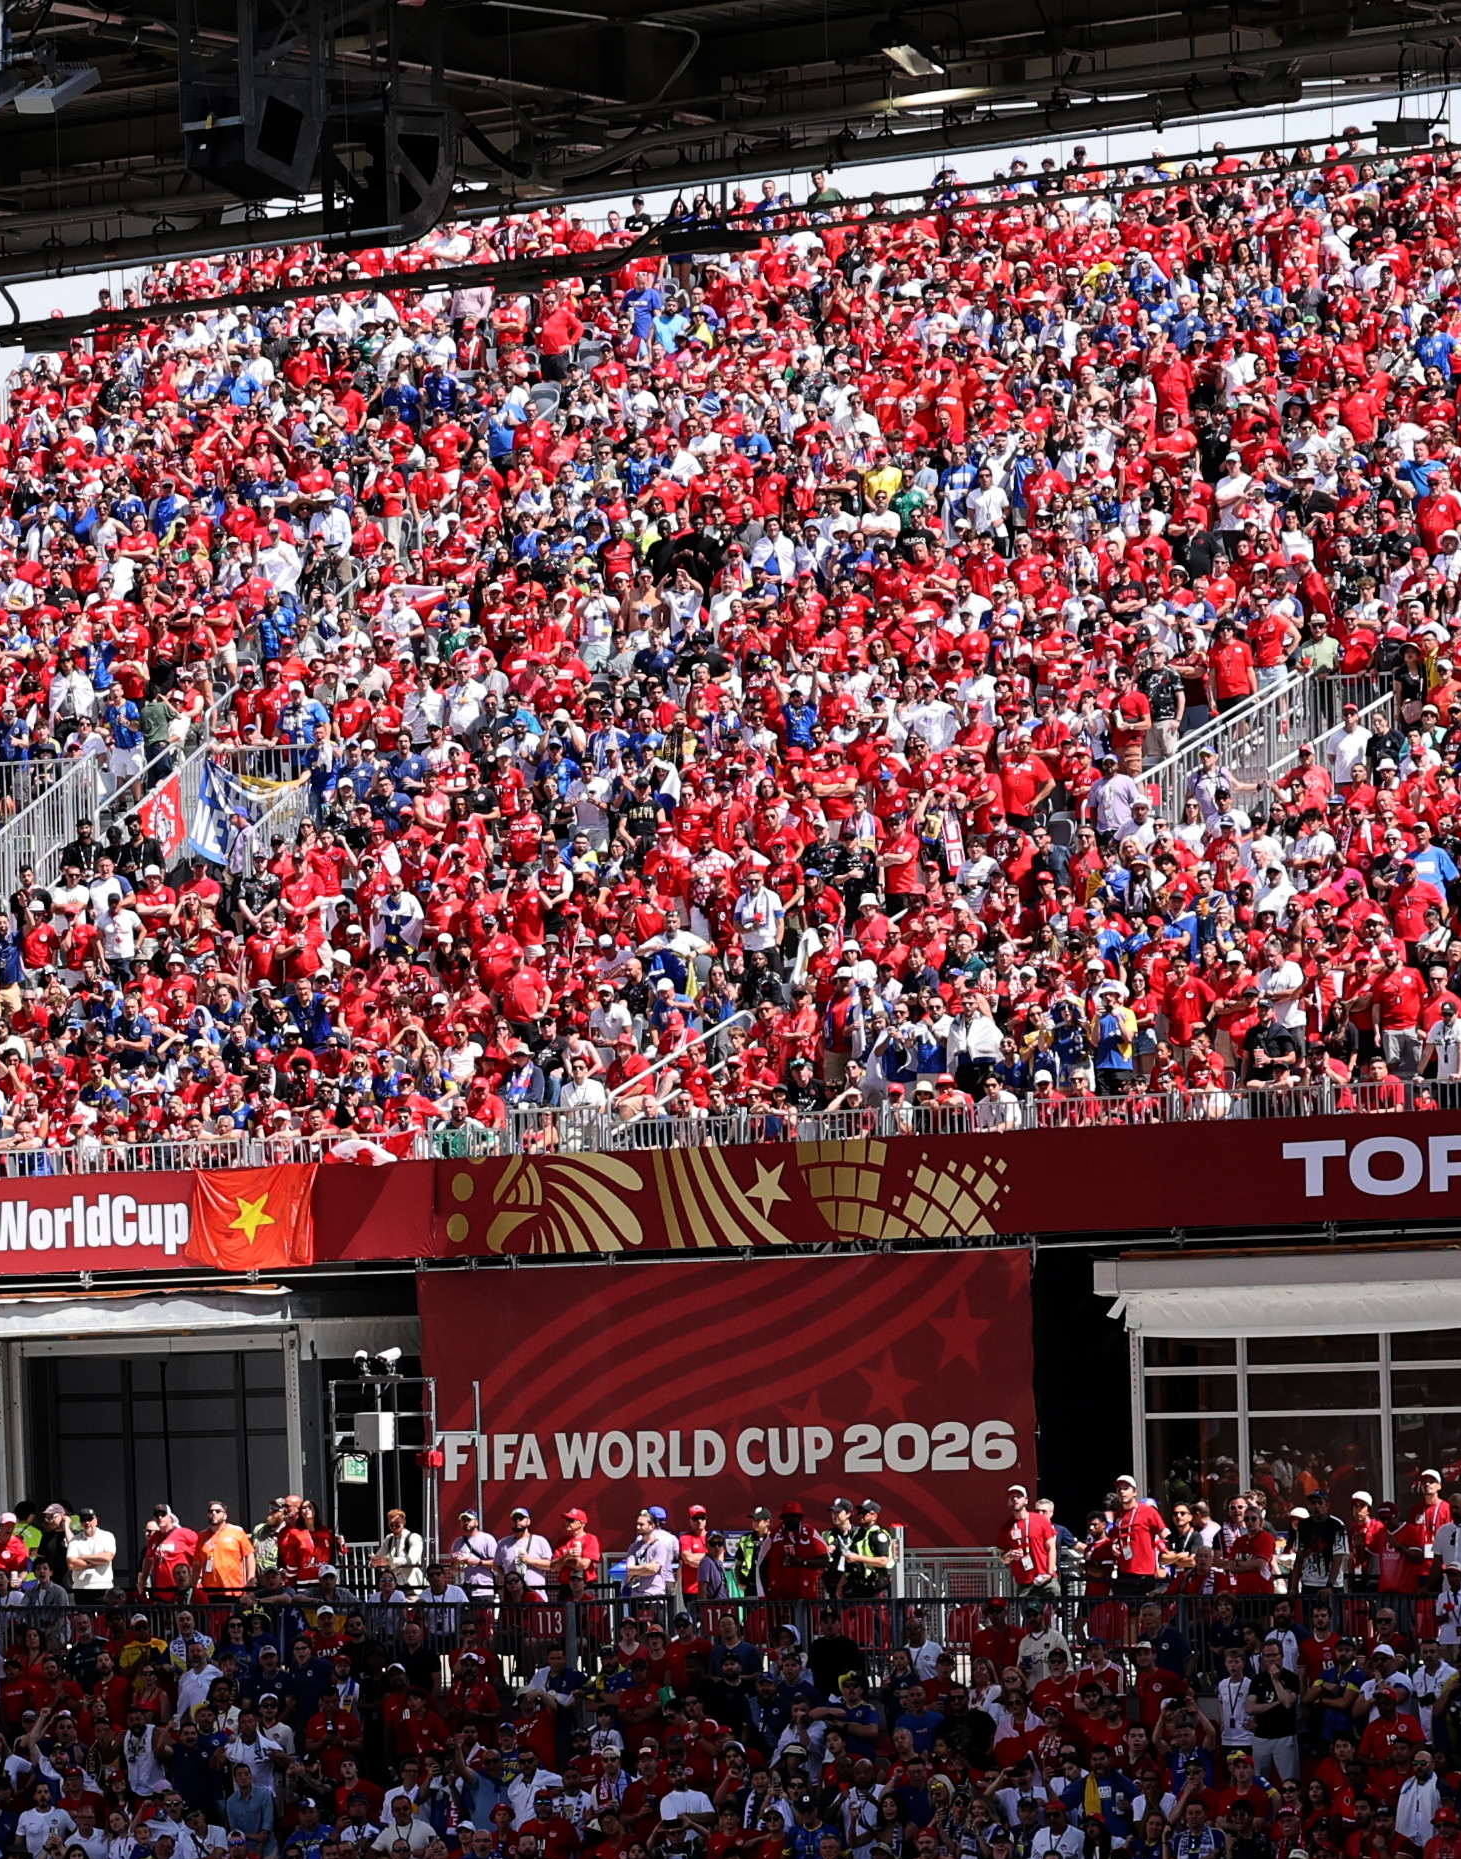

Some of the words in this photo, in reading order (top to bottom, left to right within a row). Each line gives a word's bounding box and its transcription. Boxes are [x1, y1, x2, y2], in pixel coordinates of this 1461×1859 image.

[437, 1430, 546, 1482] FIFA
[554, 1427, 727, 1480] WORLD
[736, 1424, 834, 1477] CUP
[843, 1418, 1019, 1474] 2026
[536, 1610, 564, 1635] 113
